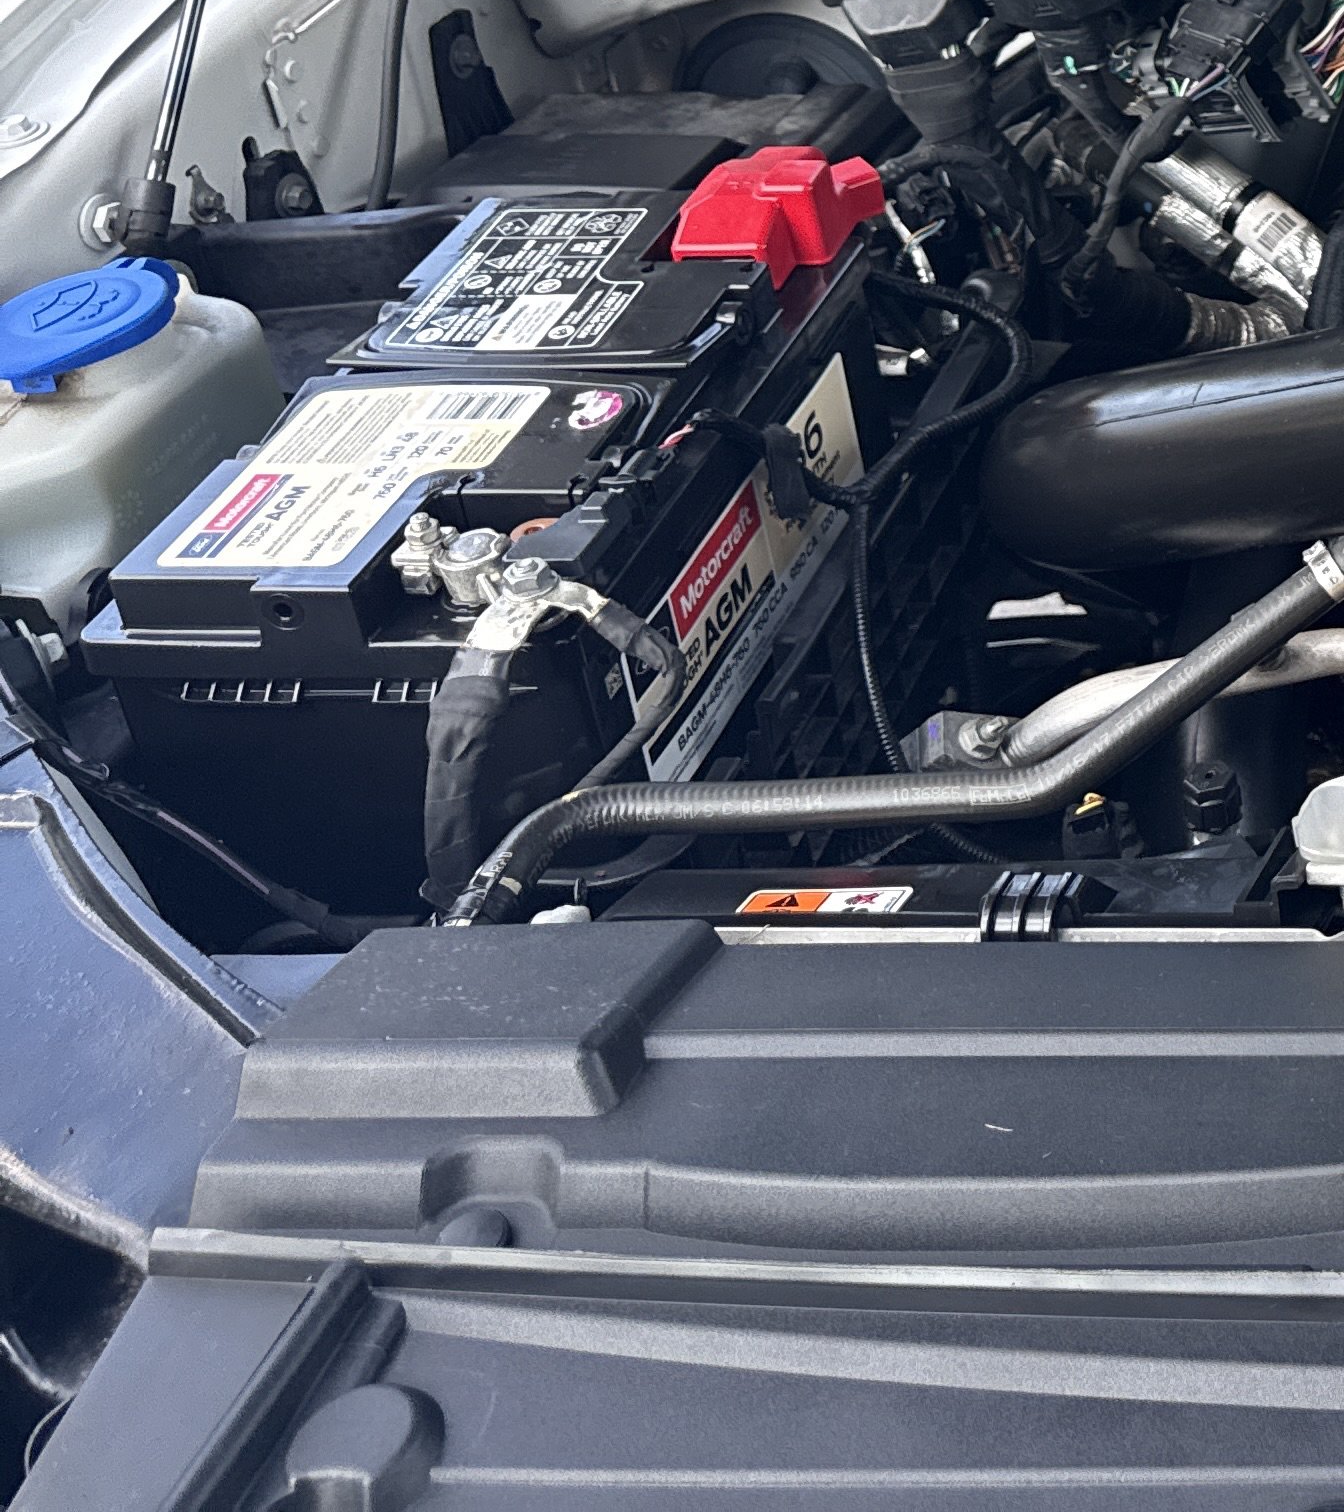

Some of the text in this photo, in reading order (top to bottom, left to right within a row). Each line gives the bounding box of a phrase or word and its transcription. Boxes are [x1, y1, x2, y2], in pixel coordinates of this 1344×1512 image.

[265, 486, 312, 521] AGM
[679, 504, 754, 619] Motorcraft
[703, 563, 753, 655] AGM
